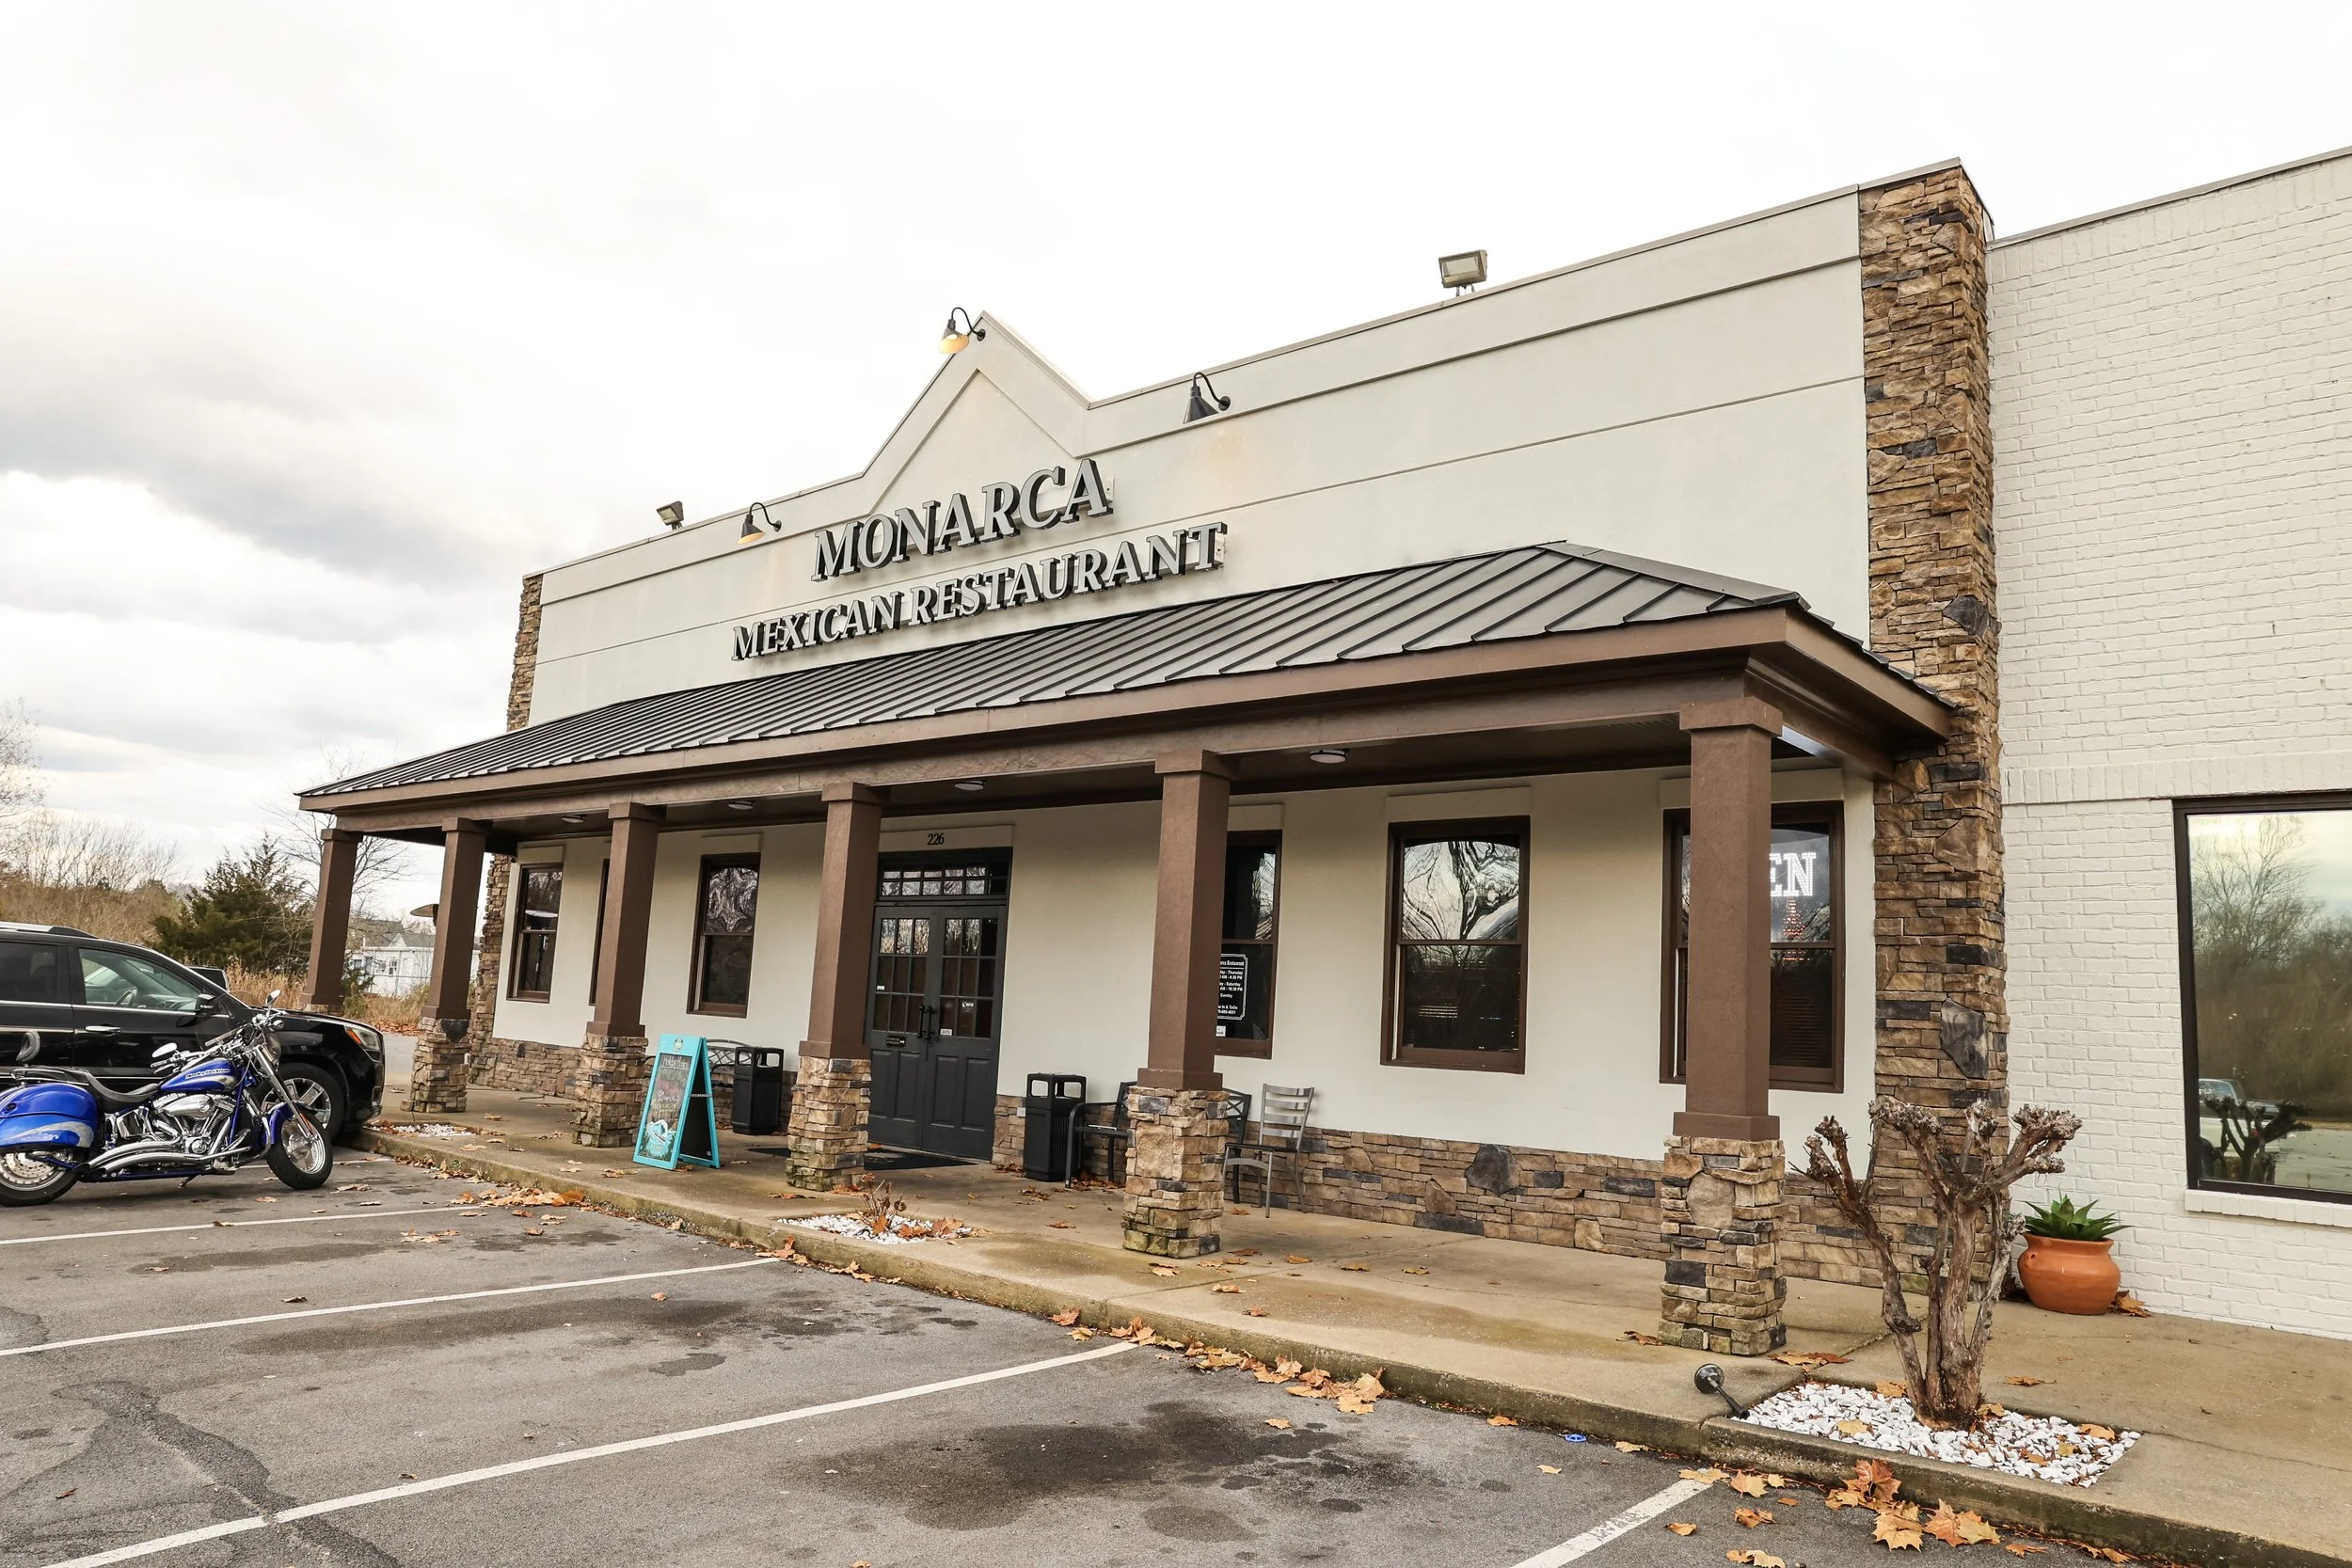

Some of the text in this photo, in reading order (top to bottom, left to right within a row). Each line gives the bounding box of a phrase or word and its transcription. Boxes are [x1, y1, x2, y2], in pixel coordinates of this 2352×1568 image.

[811, 458, 1115, 582] MONARCA
[731, 522, 1229, 661] MEXICAN RESTAURANT
[927, 832, 945, 846] 226
[1769, 851, 1817, 897] EN
